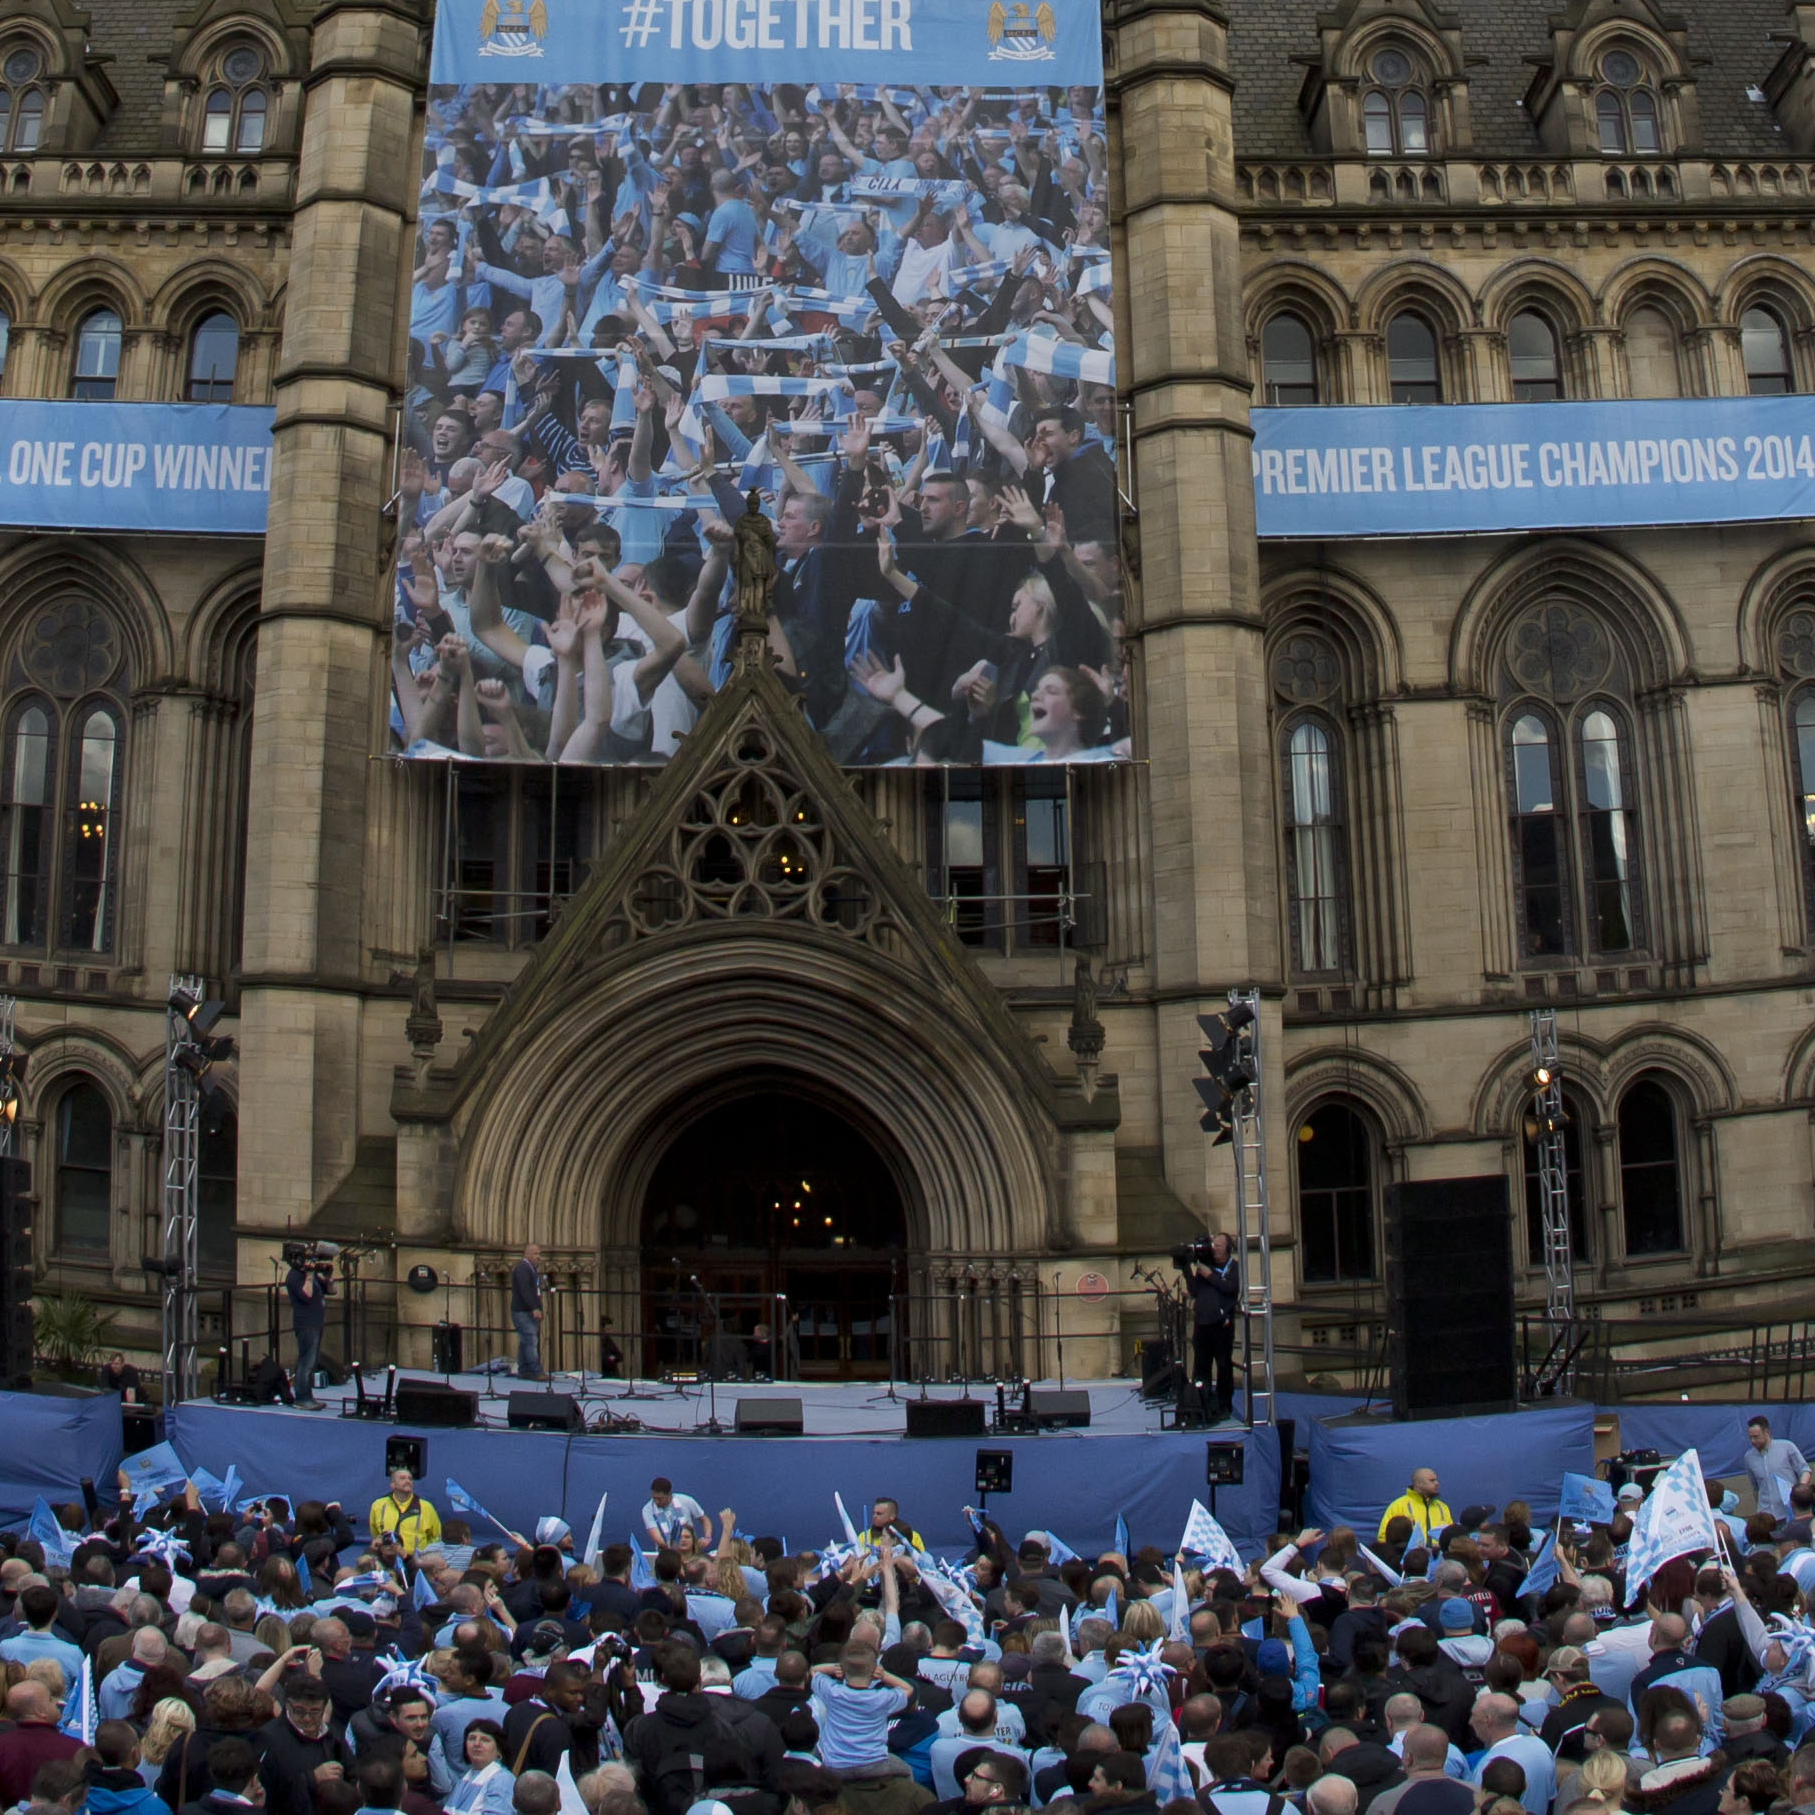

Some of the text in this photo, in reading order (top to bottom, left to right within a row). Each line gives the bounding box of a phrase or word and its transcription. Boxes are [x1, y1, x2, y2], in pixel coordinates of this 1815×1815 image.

[9, 439, 76, 487] ONE
[80, 441, 147, 489] CUP
[1402, 442, 1533, 492] LEAGUE
[1538, 435, 1739, 487] CHAMPIONS
[1743, 434, 1815, 481] 2014
